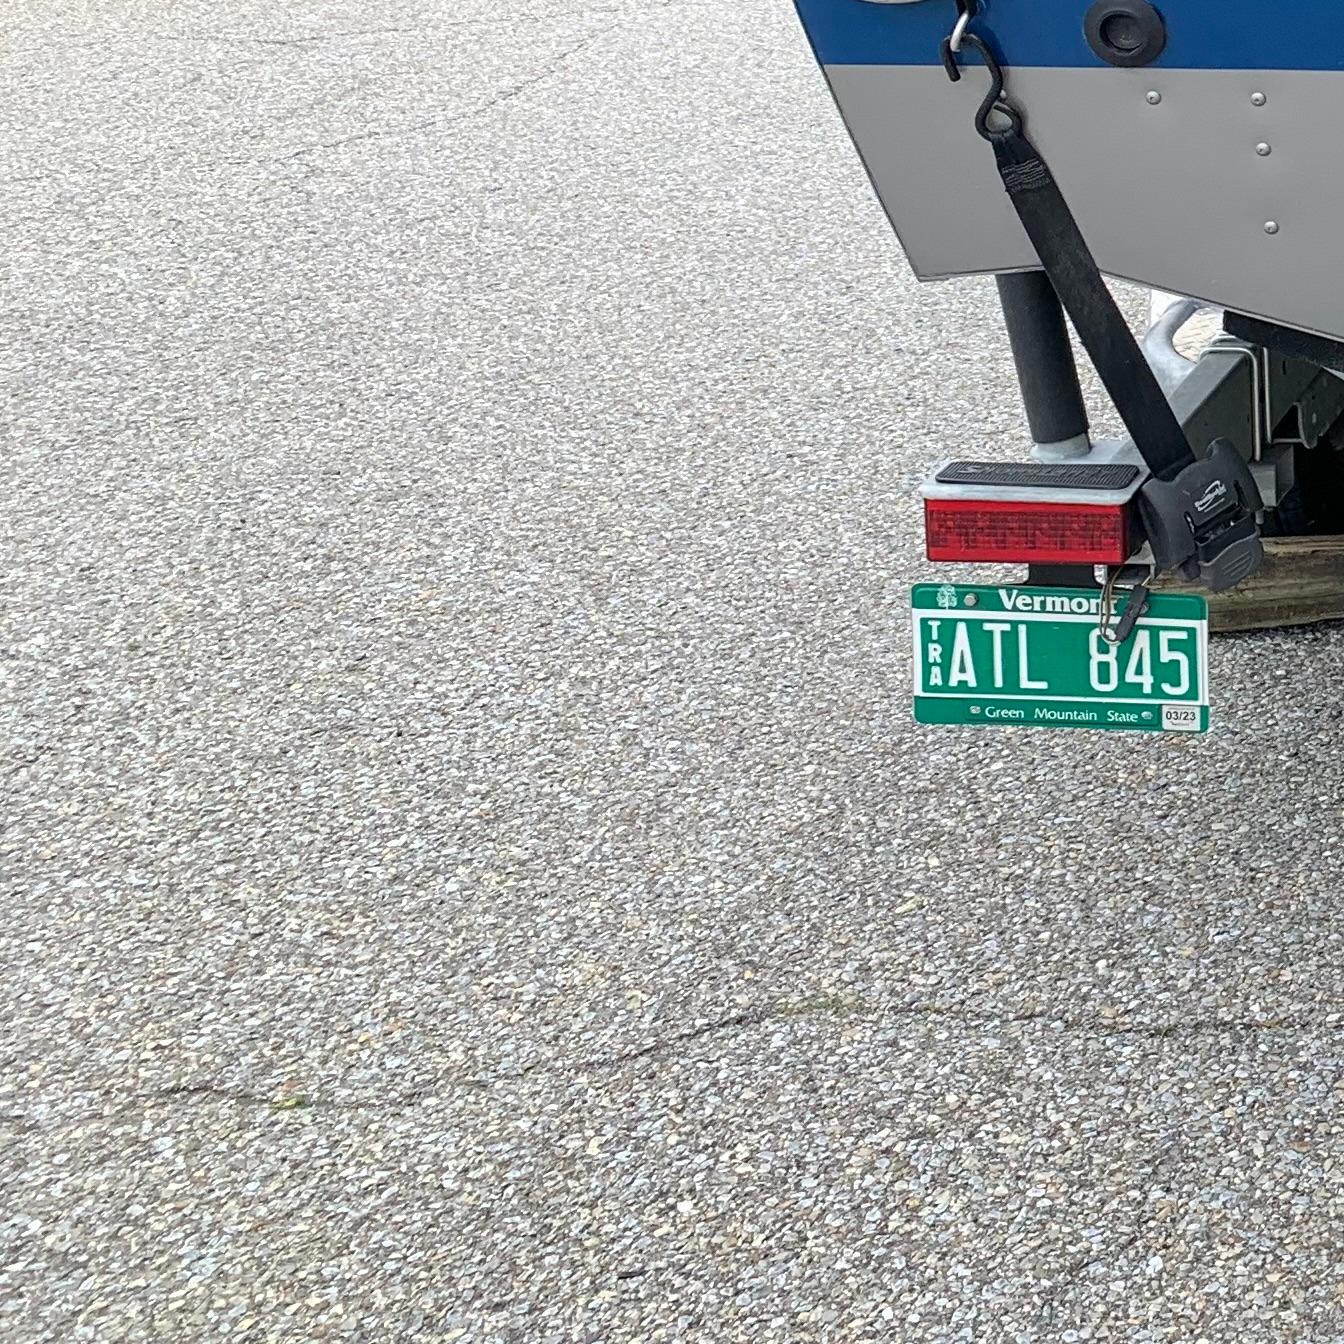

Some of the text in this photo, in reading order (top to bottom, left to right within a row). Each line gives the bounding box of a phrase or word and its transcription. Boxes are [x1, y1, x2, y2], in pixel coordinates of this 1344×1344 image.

[999, 589, 1123, 615] Vermont
[927, 620, 943, 687] TRA
[948, 621, 1190, 696] ATL 845
[985, 706, 1139, 723] Green Mountain State
[1165, 710, 1196, 721] 03/23
